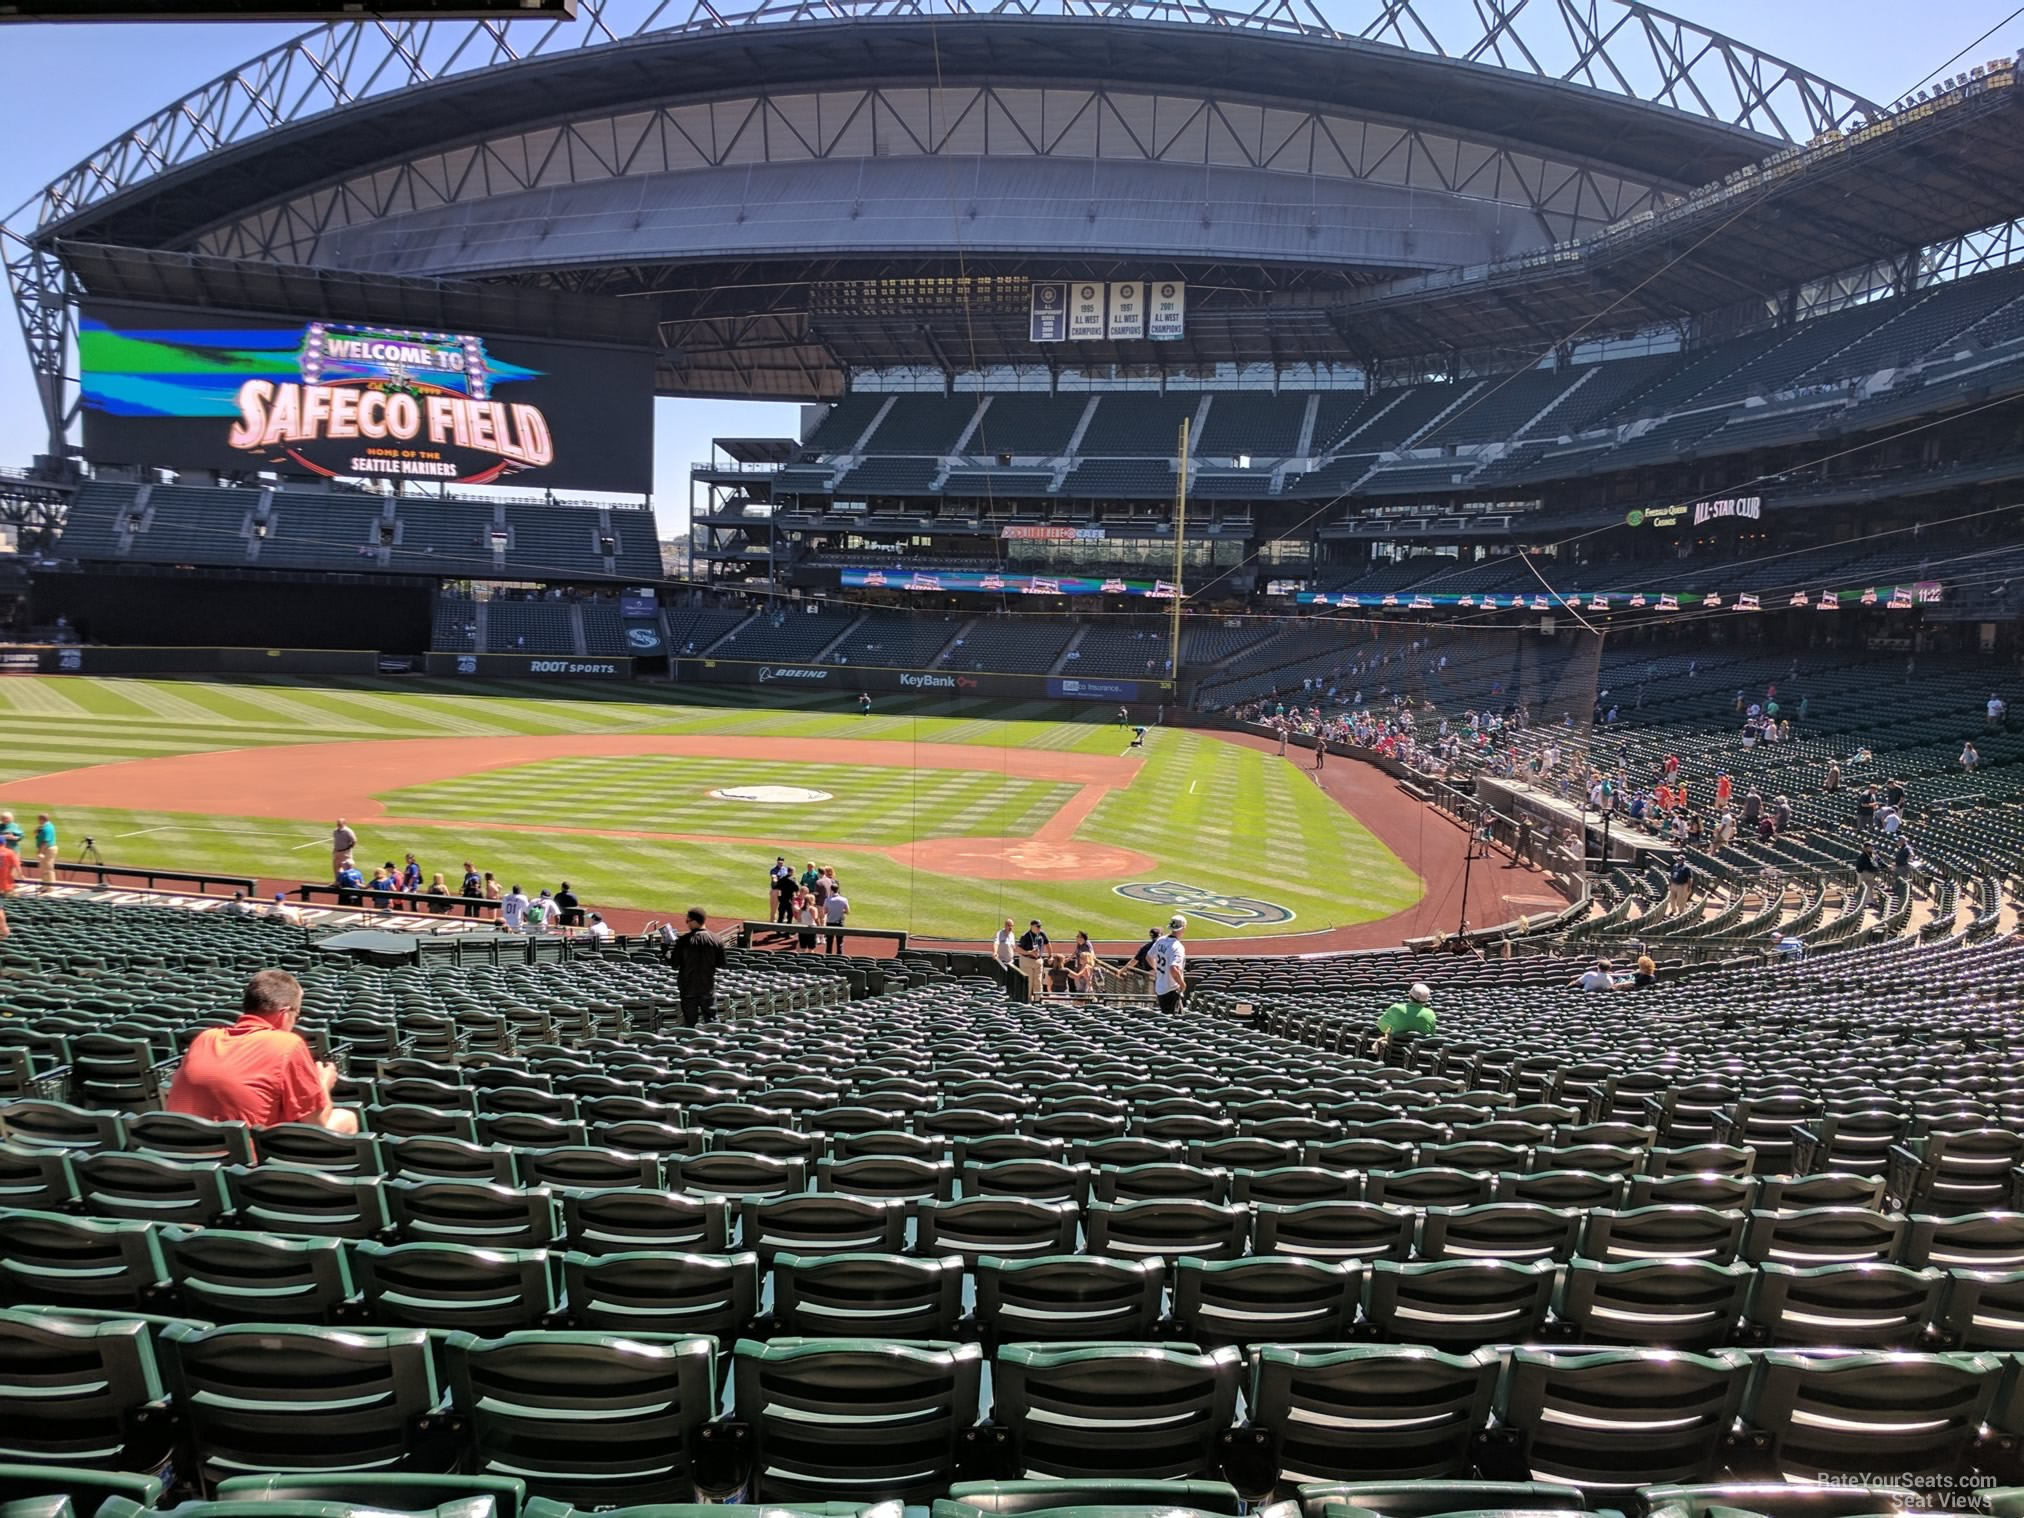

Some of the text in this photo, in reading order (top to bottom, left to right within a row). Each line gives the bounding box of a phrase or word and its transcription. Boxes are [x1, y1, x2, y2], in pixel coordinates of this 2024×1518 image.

[1081, 304, 1094, 313] 1995
[1120, 303, 1133, 312] 1997
[1160, 302, 1174, 311] 2001
[1085, 315, 1100, 324] WEST
[1124, 314, 1139, 323] WEST
[1164, 313, 1180, 321] WEST
[1072, 327, 1102, 336] CHAMPIONS
[1111, 326, 1141, 335] CHAMPIONS
[1151, 325, 1182, 333] CHAMPIONS
[327, 338, 465, 372] WELCOME TO
[228, 379, 553, 467] SAFECO FIELD
[367, 448, 441, 460] HOME OF THE
[351, 457, 457, 477] SEATTLE MARINERS
[1736, 497, 1761, 520] CLUB
[1919, 589, 1941, 602] 11:22
[531, 661, 615, 674] ROOT SPORTS
[775, 669, 828, 679] BOEING
[900, 673, 955, 688] KeyBank
